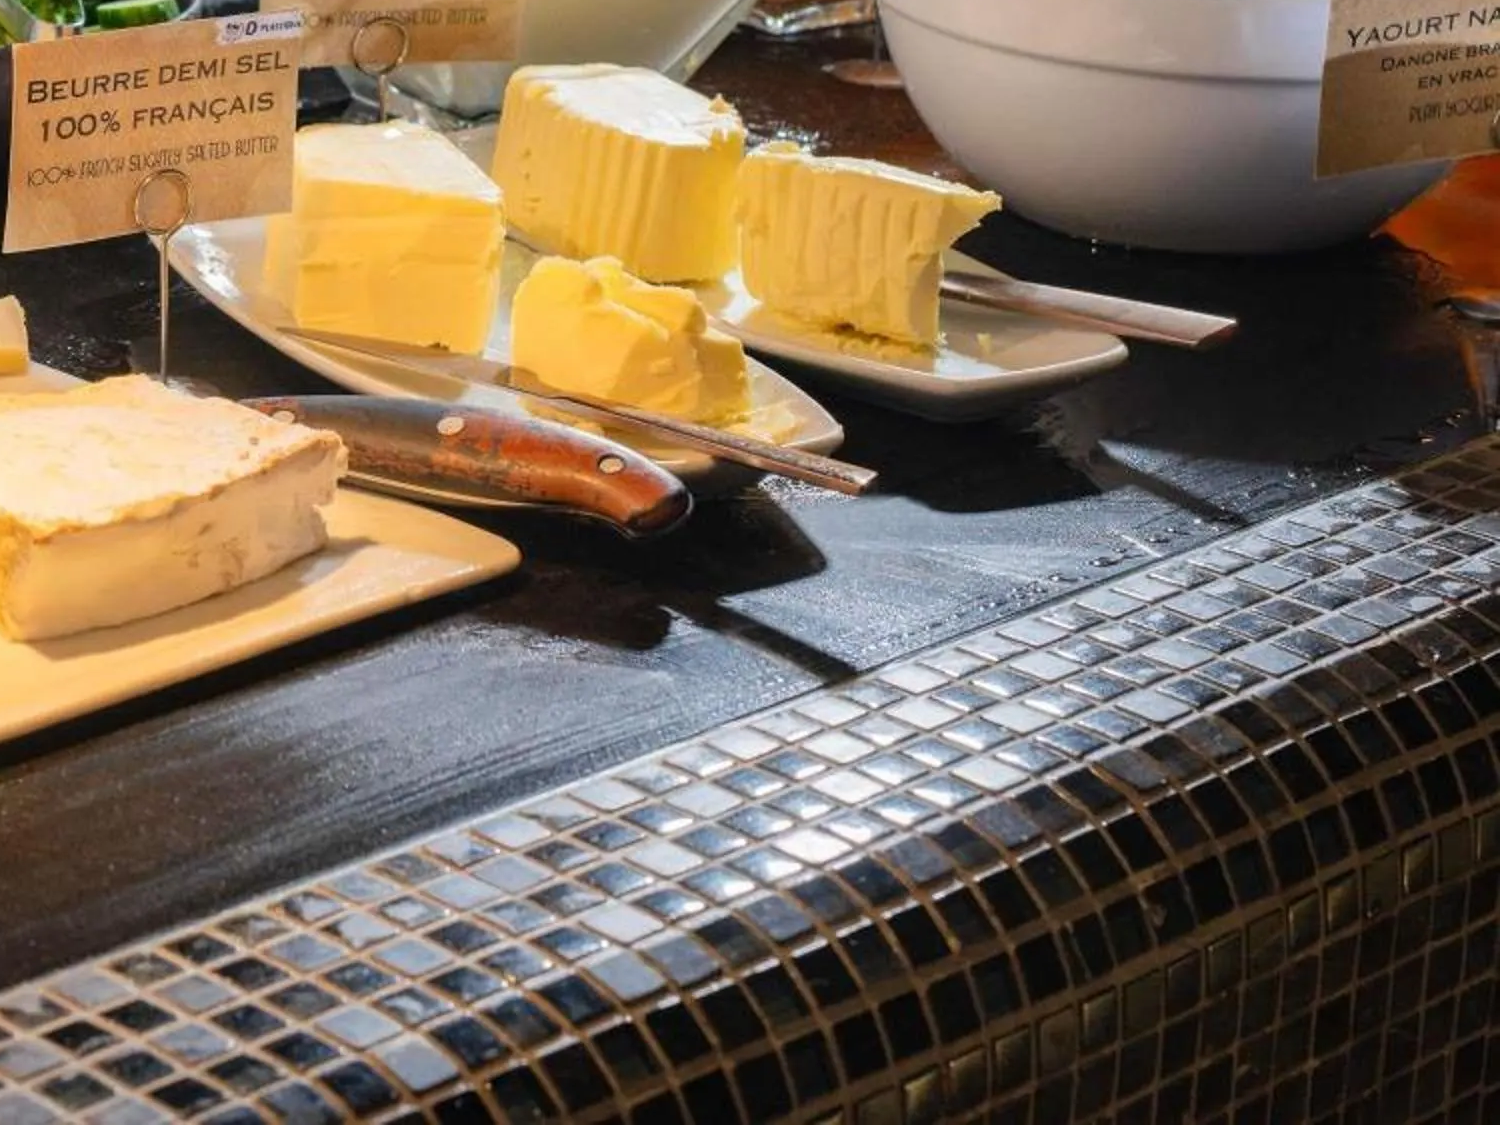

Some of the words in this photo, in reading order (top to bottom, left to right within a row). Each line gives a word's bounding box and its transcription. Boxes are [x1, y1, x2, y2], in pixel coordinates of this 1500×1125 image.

[1347, 13, 1460, 48] YAOURT
[1381, 46, 1460, 72] DANONE
[27, 69, 149, 105] BEURRE
[158, 58, 227, 85] DEMI
[235, 51, 290, 75] SEL
[1418, 74, 1442, 90] EN
[1448, 64, 1500, 85] VRAC
[40, 110, 121, 143] 100%
[132, 91, 275, 129] FRANÇAIS
